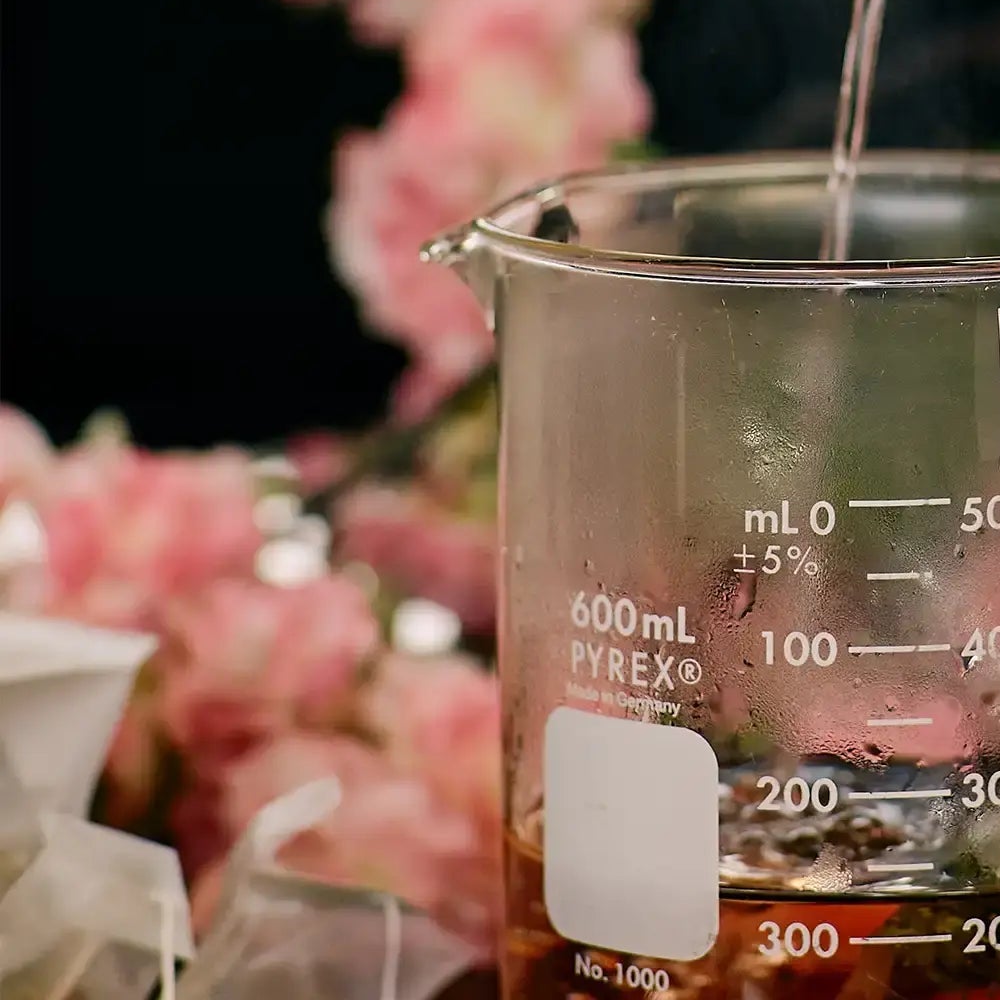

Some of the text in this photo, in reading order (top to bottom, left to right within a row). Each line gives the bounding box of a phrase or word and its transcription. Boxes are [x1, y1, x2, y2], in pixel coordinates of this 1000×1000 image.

[744, 500, 837, 536] mL 0
[760, 631, 839, 667] 100
[616, 691, 682, 718] Germany
[756, 775, 839, 813] 200
[757, 920, 840, 959] 300
[574, 952, 670, 992] No. 1000
